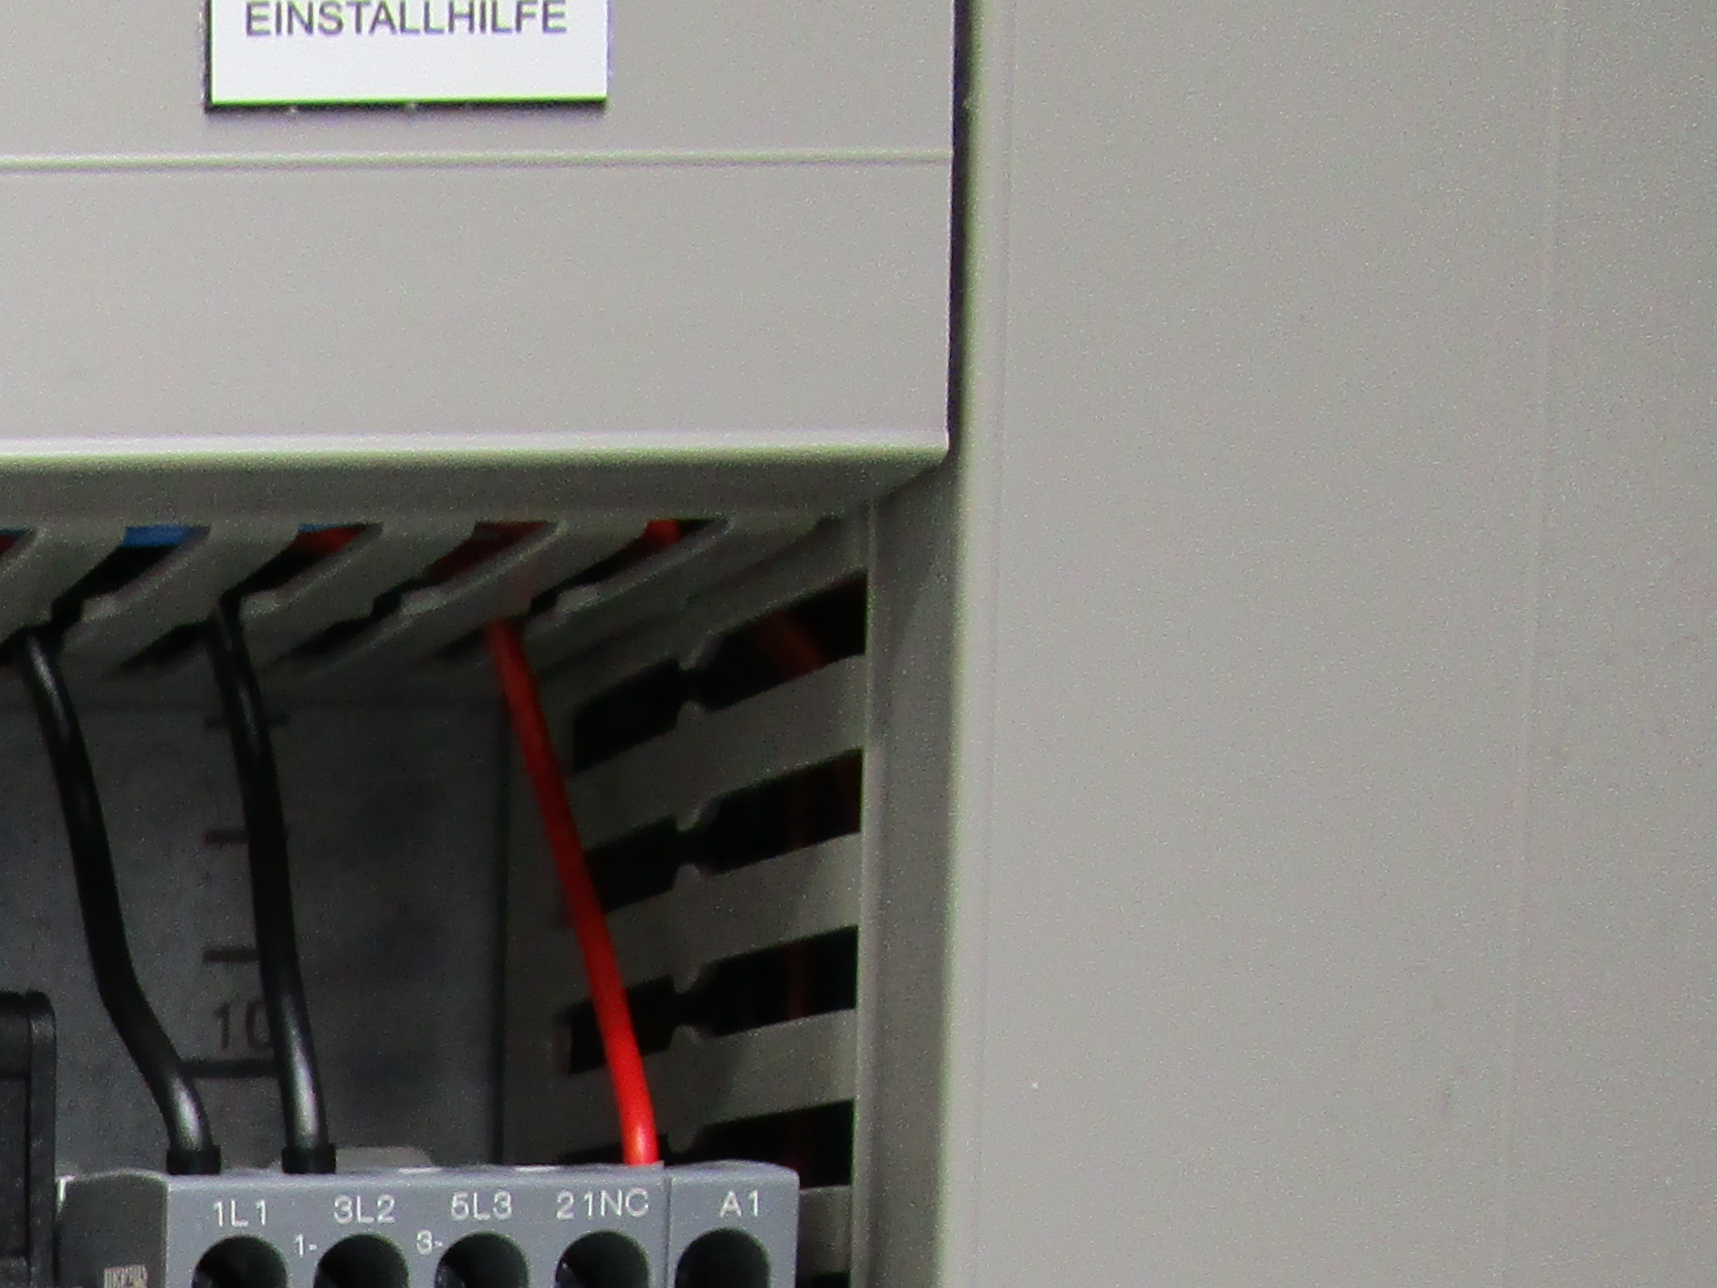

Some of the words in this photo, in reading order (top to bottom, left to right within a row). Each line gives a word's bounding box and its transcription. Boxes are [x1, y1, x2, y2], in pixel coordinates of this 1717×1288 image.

[245, 0, 568, 36] EINSTALLHILFE
[213, 1201, 267, 1228] 1L1
[334, 1195, 395, 1223] 3L2
[451, 1192, 513, 1220] 5L3
[557, 1190, 650, 1219] 21NC
[719, 1190, 760, 1217] A1
